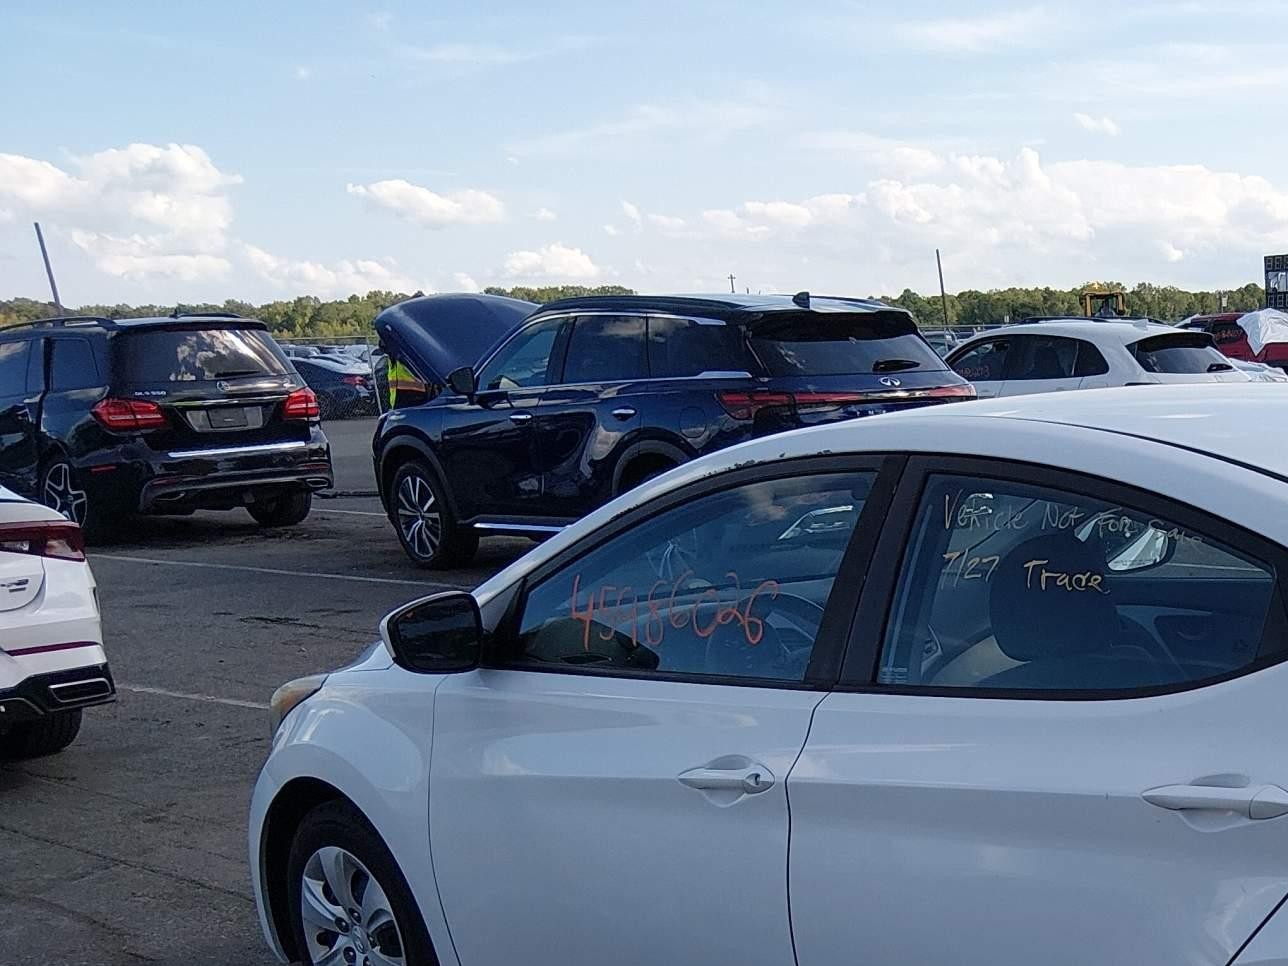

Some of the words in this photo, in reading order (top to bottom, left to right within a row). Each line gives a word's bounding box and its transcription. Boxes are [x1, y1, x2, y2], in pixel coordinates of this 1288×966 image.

[945, 489, 1029, 531] Vehicle
[1041, 503, 1084, 530] Not
[943, 548, 1000, 588] 7/27
[572, 569, 778, 651] 45986026
